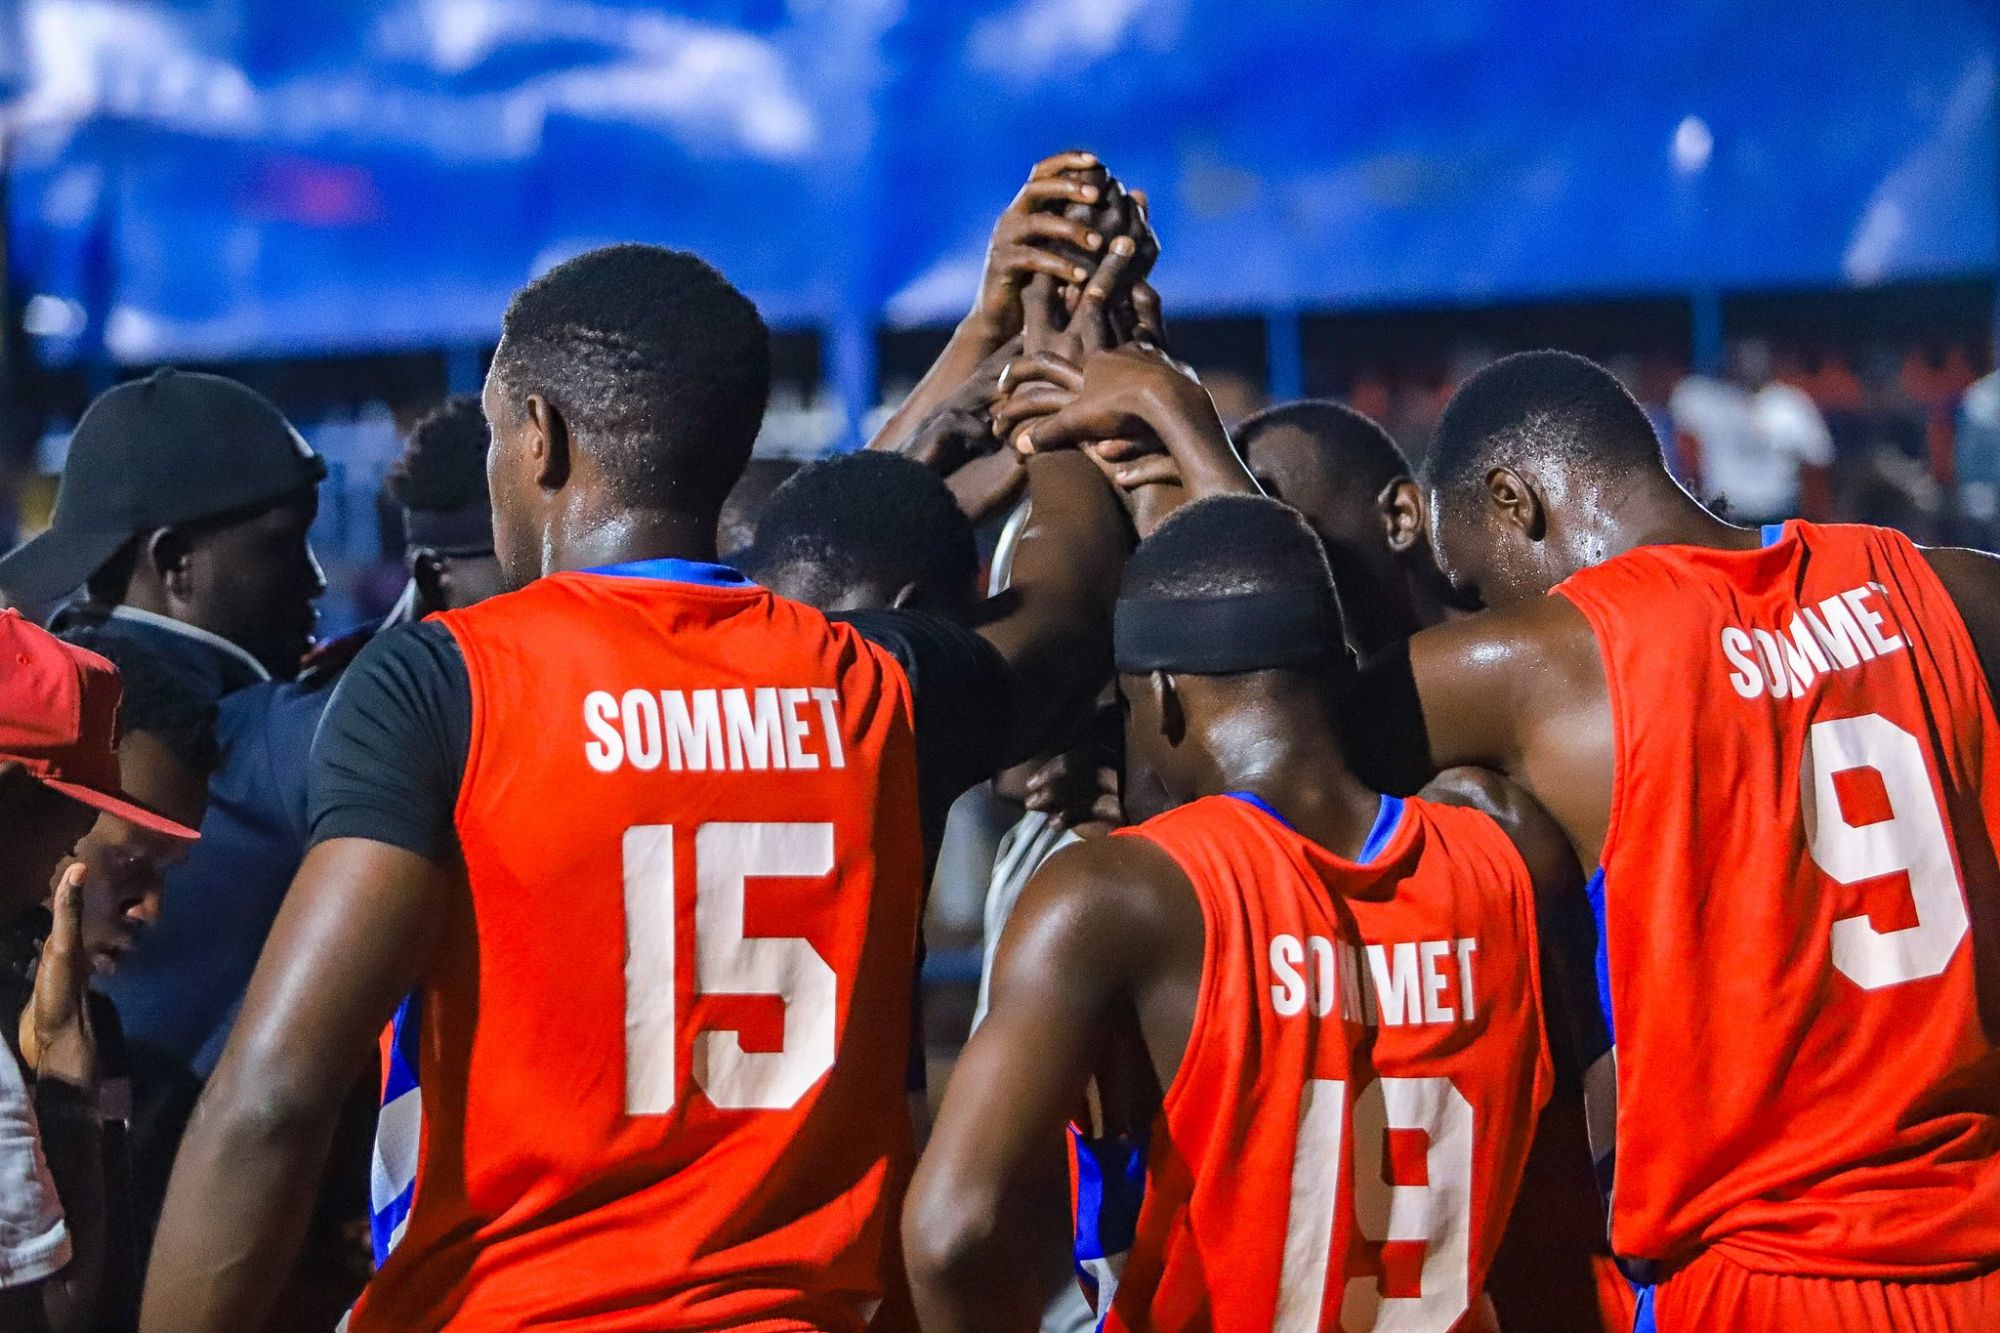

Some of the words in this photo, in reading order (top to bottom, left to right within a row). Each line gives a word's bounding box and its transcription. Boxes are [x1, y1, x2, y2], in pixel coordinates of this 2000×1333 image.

[584, 687, 845, 772] SOMMET
[1800, 712, 1969, 990] 9
[622, 822, 837, 1116] 15
[1272, 1076, 1473, 1333] 19
